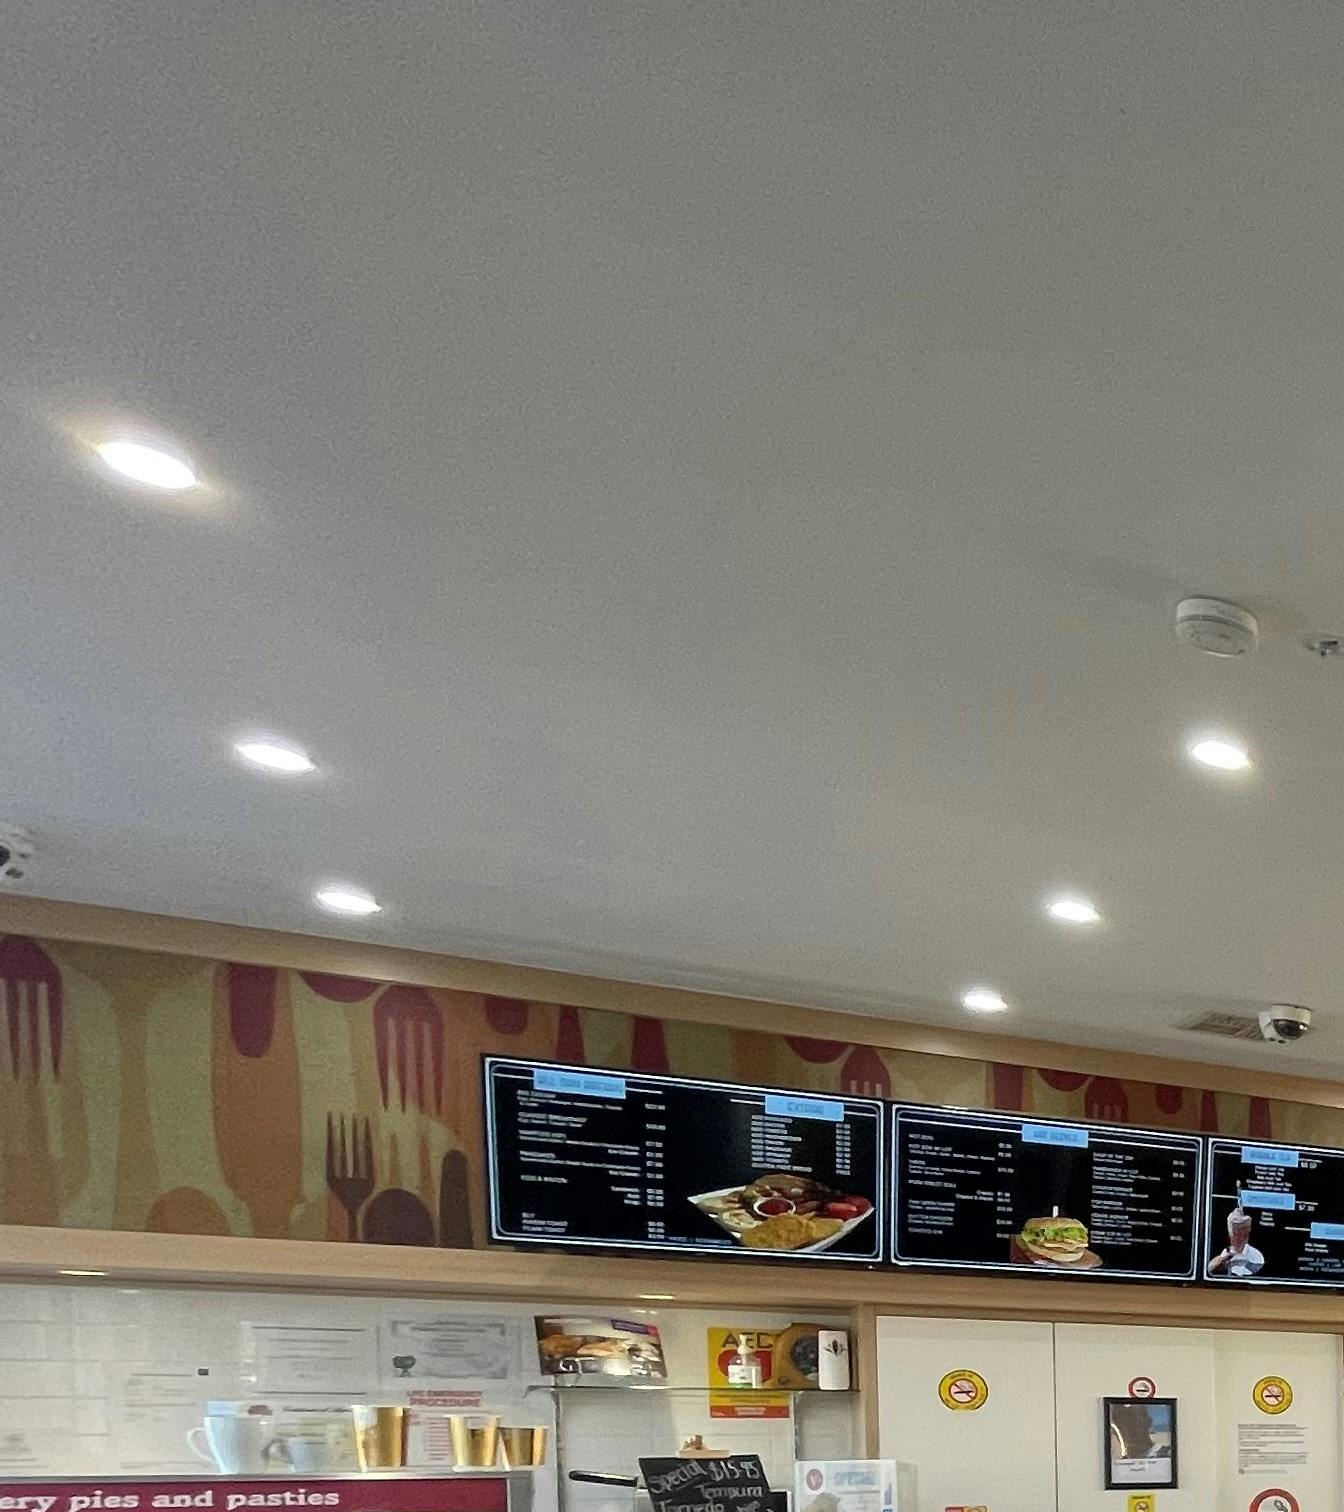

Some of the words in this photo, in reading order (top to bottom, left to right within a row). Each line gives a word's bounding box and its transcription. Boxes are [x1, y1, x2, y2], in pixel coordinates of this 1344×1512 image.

[650, 1460, 708, 1494] Special
[151, 1489, 215, 1508] and
[226, 1488, 341, 1512] pasties
